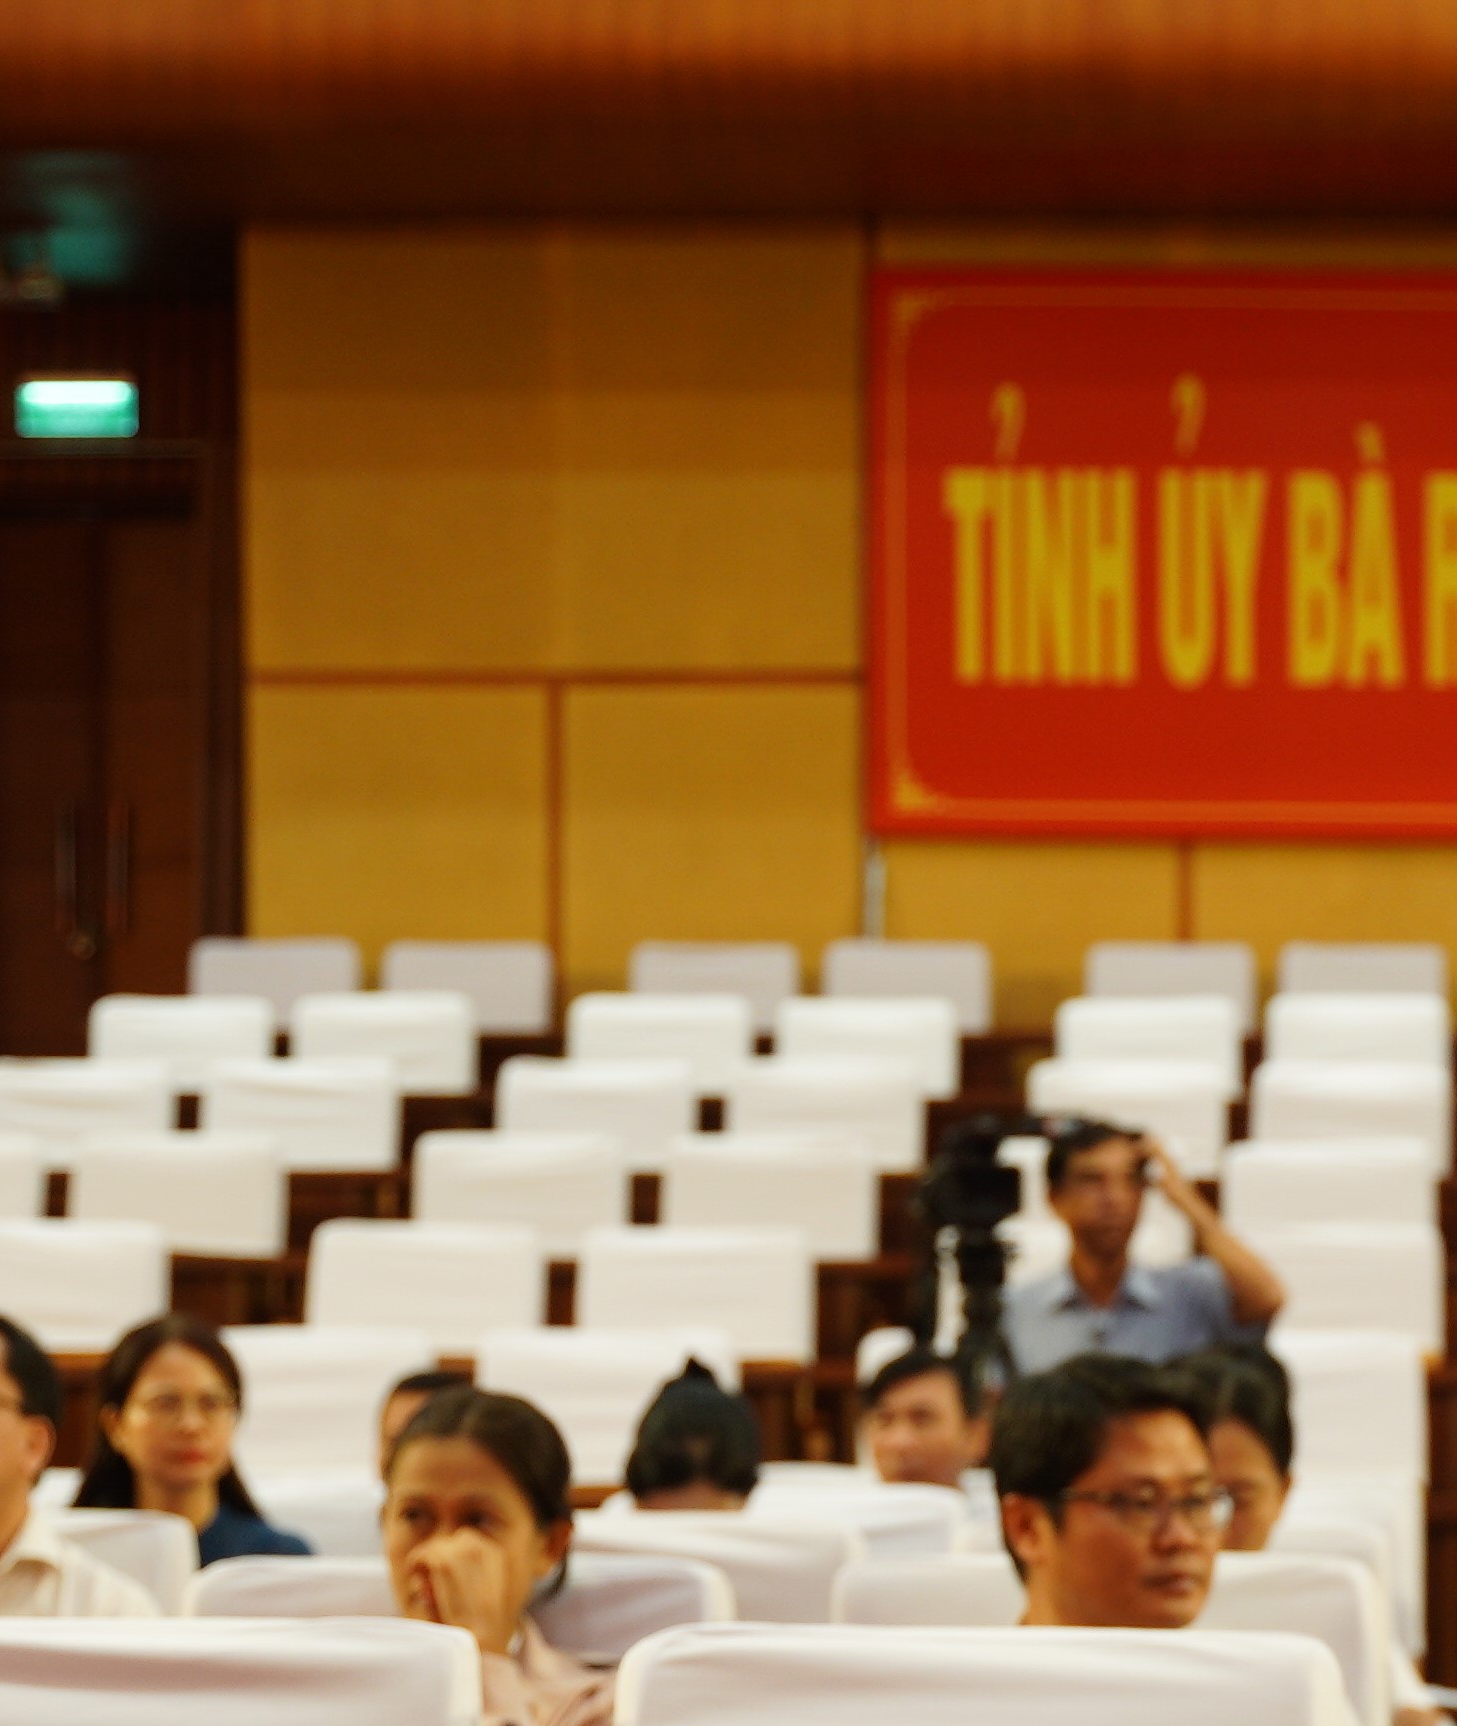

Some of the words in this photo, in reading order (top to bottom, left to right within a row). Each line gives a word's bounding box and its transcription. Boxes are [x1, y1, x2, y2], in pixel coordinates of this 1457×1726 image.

[940, 382, 1138, 686] TỈNH
[1155, 375, 1270, 690] ỦY
[1284, 422, 1407, 689] BÀ
